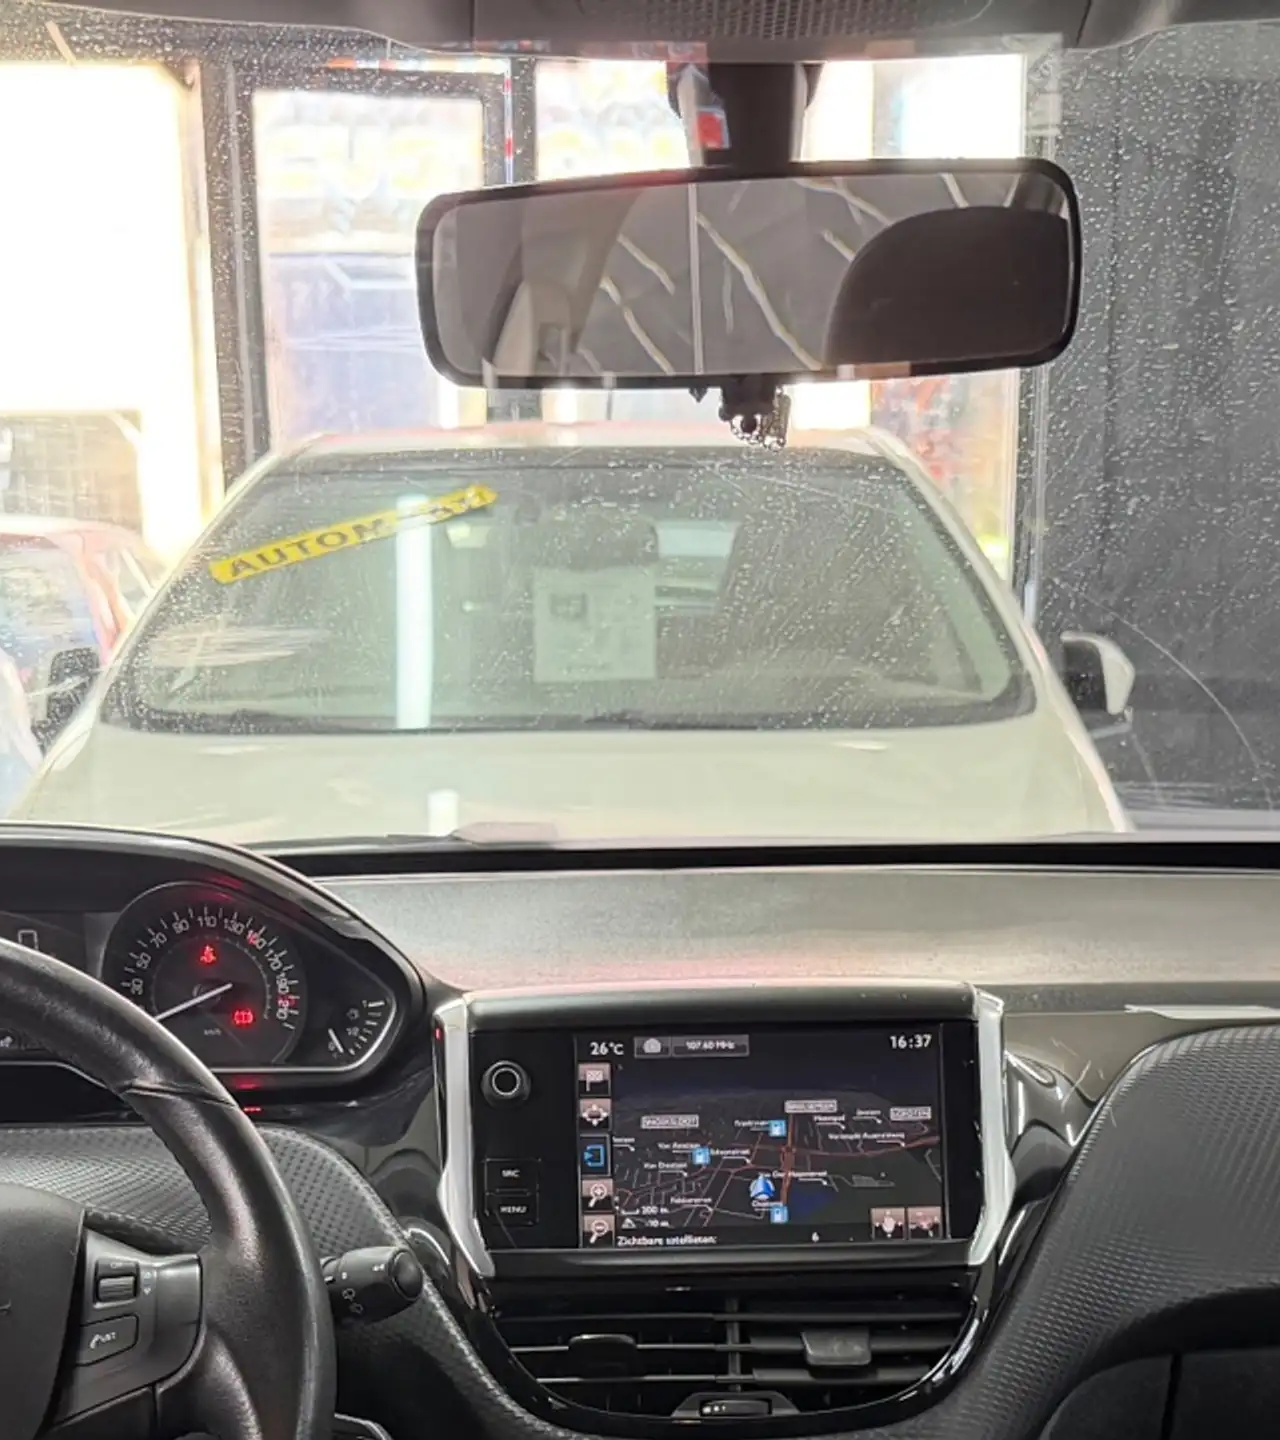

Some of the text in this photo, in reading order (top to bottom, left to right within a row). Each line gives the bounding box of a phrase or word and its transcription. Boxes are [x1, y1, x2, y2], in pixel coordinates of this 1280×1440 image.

[197, 915, 217, 928] 110
[223, 918, 245, 935] 130
[150, 932, 168, 949] 70
[264, 949, 283, 971] 170
[589, 1041, 625, 1056] 26°C
[889, 1034, 933, 1049] 16:37
[500, 1205, 528, 1214] MENU
